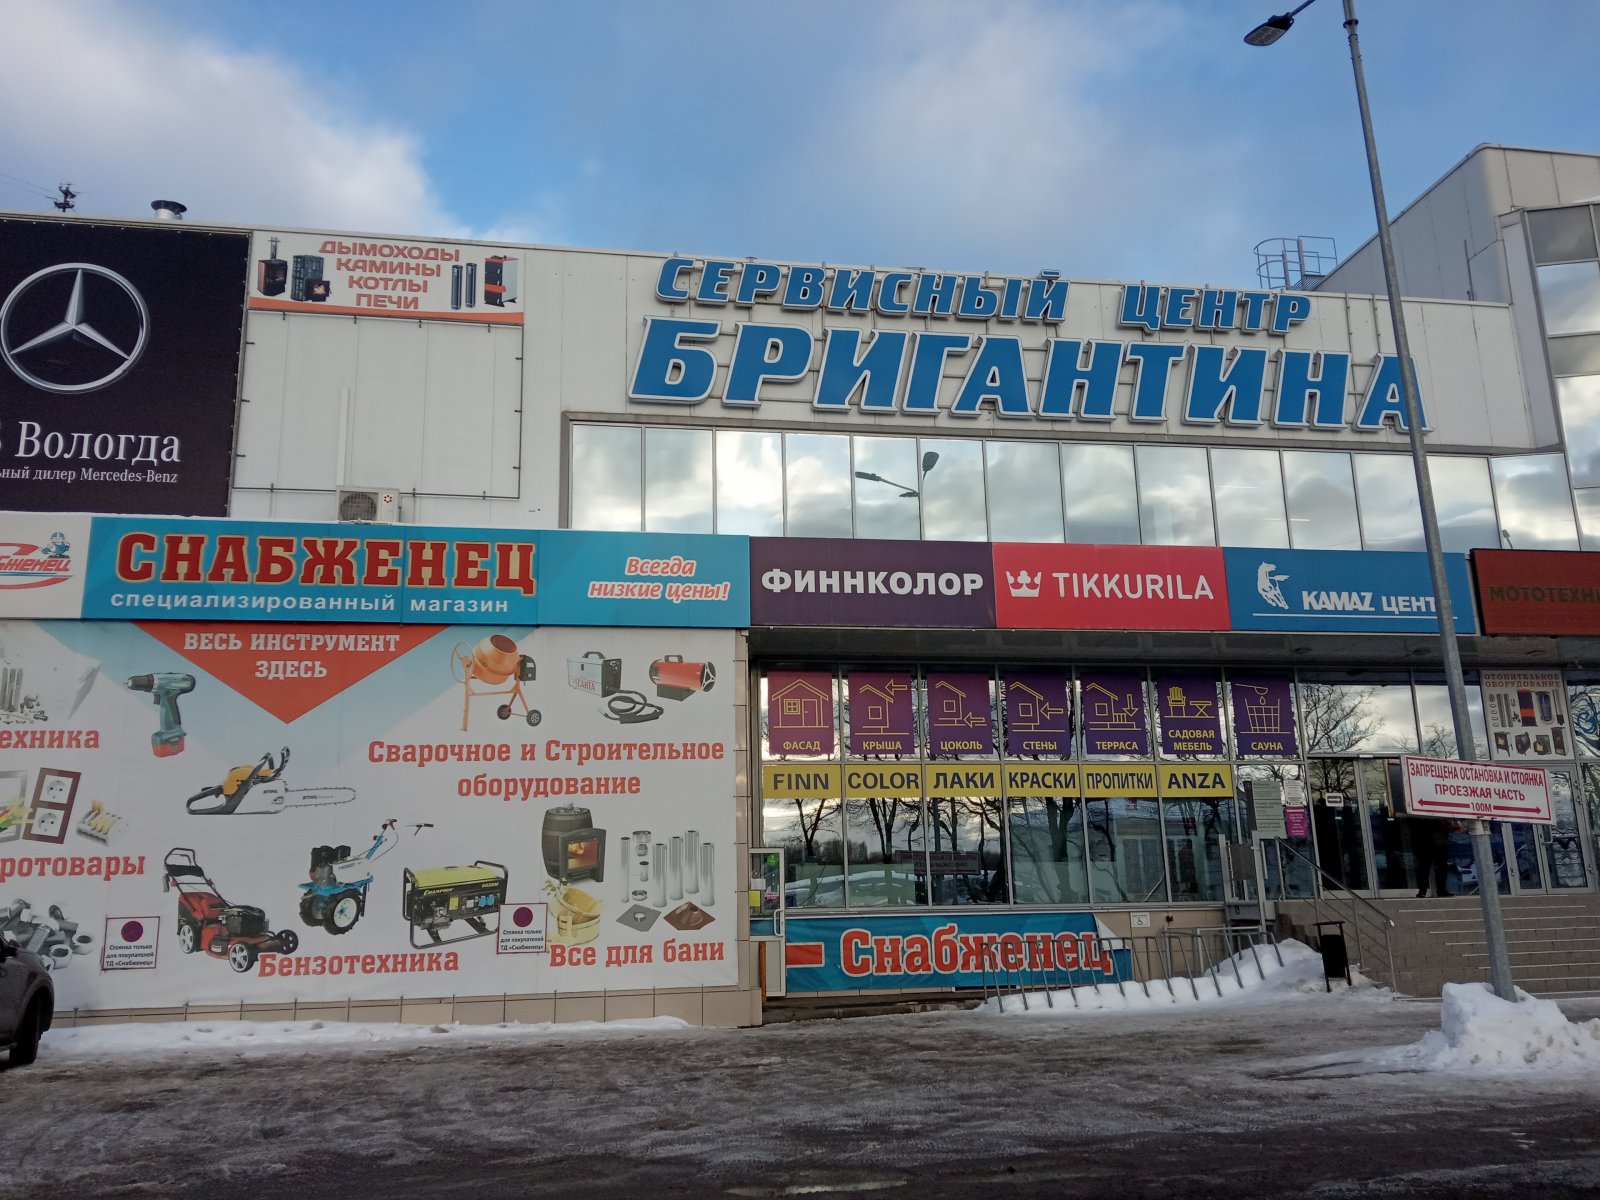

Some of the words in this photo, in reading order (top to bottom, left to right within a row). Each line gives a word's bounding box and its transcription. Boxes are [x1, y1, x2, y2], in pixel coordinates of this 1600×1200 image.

[319, 241, 460, 262] ДЫМОХОДЫ
[336, 258, 441, 277] КАМИНЫ
[348, 275, 428, 293] КОТЛЫ
[356, 293, 419, 310] ПЕЧИ
[655, 255, 1070, 324] СЕРВИСНЫЙ
[1119, 282, 1312, 335] ЦЕНТР
[628, 316, 1433, 432] БРИГАНТИНА
[14, 421, 181, 466] Вологда
[0, 466, 30, 480] ный
[33, 468, 76, 483] дилер
[80, 467, 178, 483] Mercedes-Benz
[116, 532, 536, 597] СНАБЖЕНЕЦ
[626, 556, 697, 577] Всегда
[761, 568, 984, 596] ФИННКОЛОР
[1051, 571, 1214, 600] TIKKURILA
[588, 580, 663, 599] низкие
[665, 581, 731, 604] цены!
[111, 591, 395, 612] специализированный
[411, 598, 508, 612] магазин
[1302, 590, 1375, 612] KAMAZ
[1381, 595, 1437, 614] ЦЕНТ
[184, 632, 242, 651] ВЕСЬ
[250, 633, 400, 652] ИНСТРУМЕНТ
[255, 660, 328, 679] ЗДЕСЬ
[1484, 673, 1560, 681] ОТОПИТЕЛЬНОЕ
[1485, 680, 1561, 688] ОБОРУДОВАНИЕ
[0, 729, 100, 749] ехника
[1168, 728, 1215, 741] САДОВАЯ
[368, 740, 511, 768] Сварочное
[520, 743, 536, 761] и
[545, 739, 724, 765] Строительное
[783, 740, 821, 752] ФАСАД
[862, 740, 903, 751] КРЫША
[940, 740, 983, 753] ЦОКОЛЬ
[1022, 740, 1057, 751] СТЕНЫ
[1095, 740, 1139, 751] ТЕРРАСА
[1173, 740, 1213, 752] МЕБЕЛЬ
[1250, 740, 1284, 752] САУНА
[773, 772, 829, 790] FINN
[847, 771, 920, 789] COLOR
[933, 771, 995, 788] ЛАКИ
[1008, 770, 1077, 788] КРАСКИ
[1086, 771, 1153, 789] ПРОПИТКИ
[1167, 772, 1225, 790] ANZA
[1410, 763, 1459, 781] ЗАПРЕЩЕНА
[1460, 767, 1502, 783] ОСТАНОВКА
[1504, 770, 1510, 784] И
[1511, 771, 1544, 786] СТОЯНКА
[458, 773, 641, 801] оборудование
[1435, 784, 1492, 798] ПРОЕЗЖАЯ
[1494, 788, 1525, 801] ЧАСТЬ
[1470, 802, 1493, 812] 100М
[550, 943, 597, 967] Все
[605, 942, 653, 968] для
[663, 937, 725, 963] бани
[840, 923, 1113, 977] Снабженец
[258, 951, 459, 977] Бензотехника
